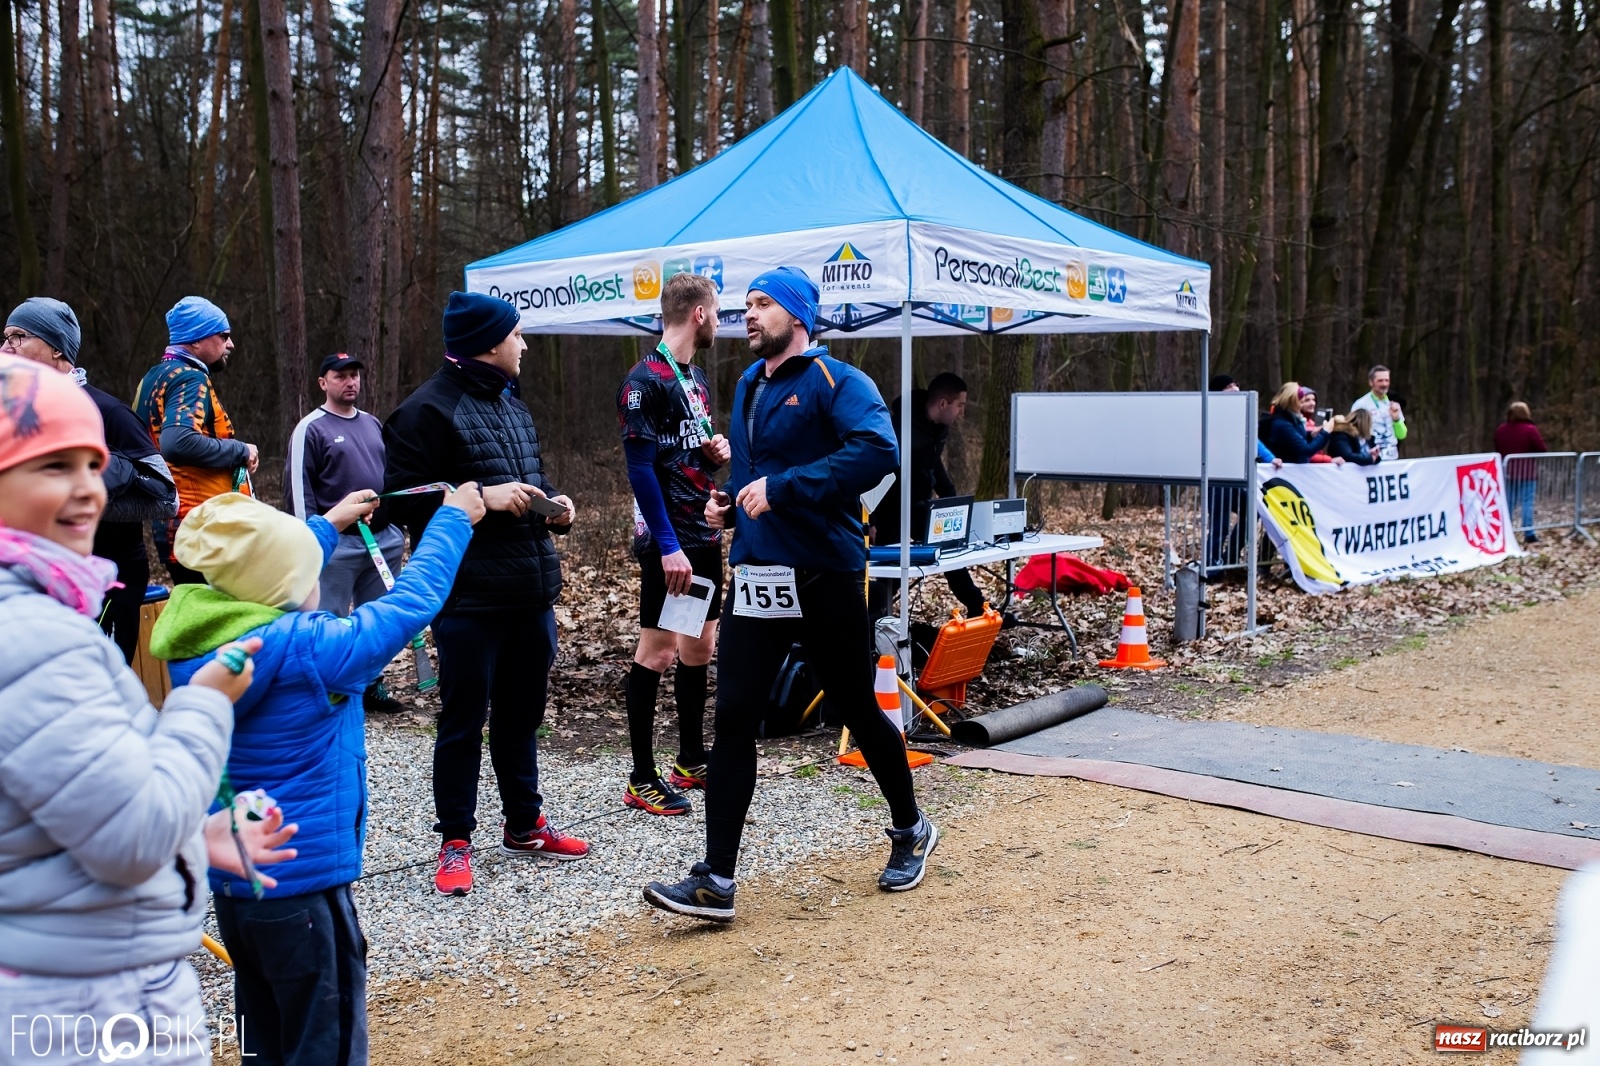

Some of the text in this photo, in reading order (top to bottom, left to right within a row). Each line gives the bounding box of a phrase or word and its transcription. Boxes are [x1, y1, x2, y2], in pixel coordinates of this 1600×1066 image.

[822, 262, 873, 283] MITKO
[934, 246, 1061, 292] PersonalBest
[1366, 474, 1409, 504] BIEG
[1331, 511, 1447, 555] TWARDZIELA
[740, 582, 794, 609] 155
